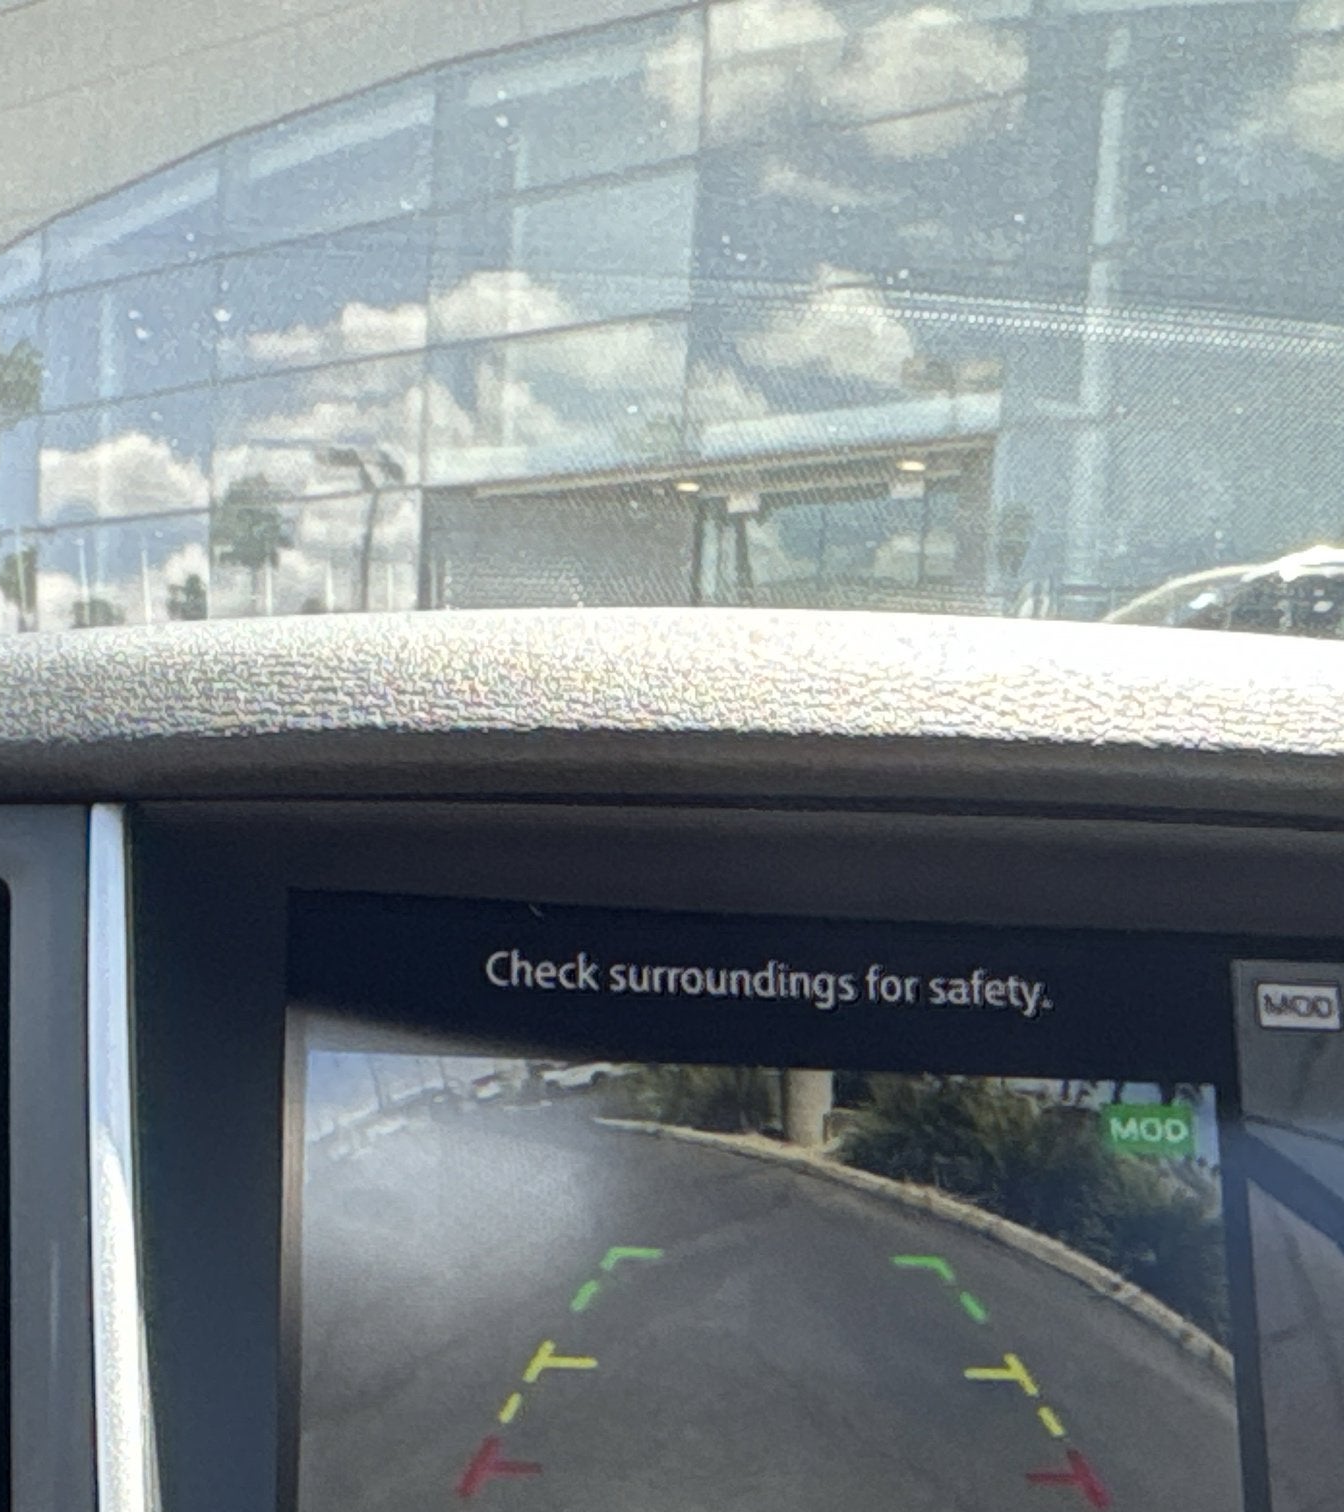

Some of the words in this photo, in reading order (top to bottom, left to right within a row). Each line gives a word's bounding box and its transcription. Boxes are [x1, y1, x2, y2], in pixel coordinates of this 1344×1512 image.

[486, 949, 599, 992] Check
[609, 958, 855, 1009] surroundings
[866, 964, 917, 1002] for
[928, 969, 1053, 1017] safety.
[1110, 1117, 1189, 1143] MOD
